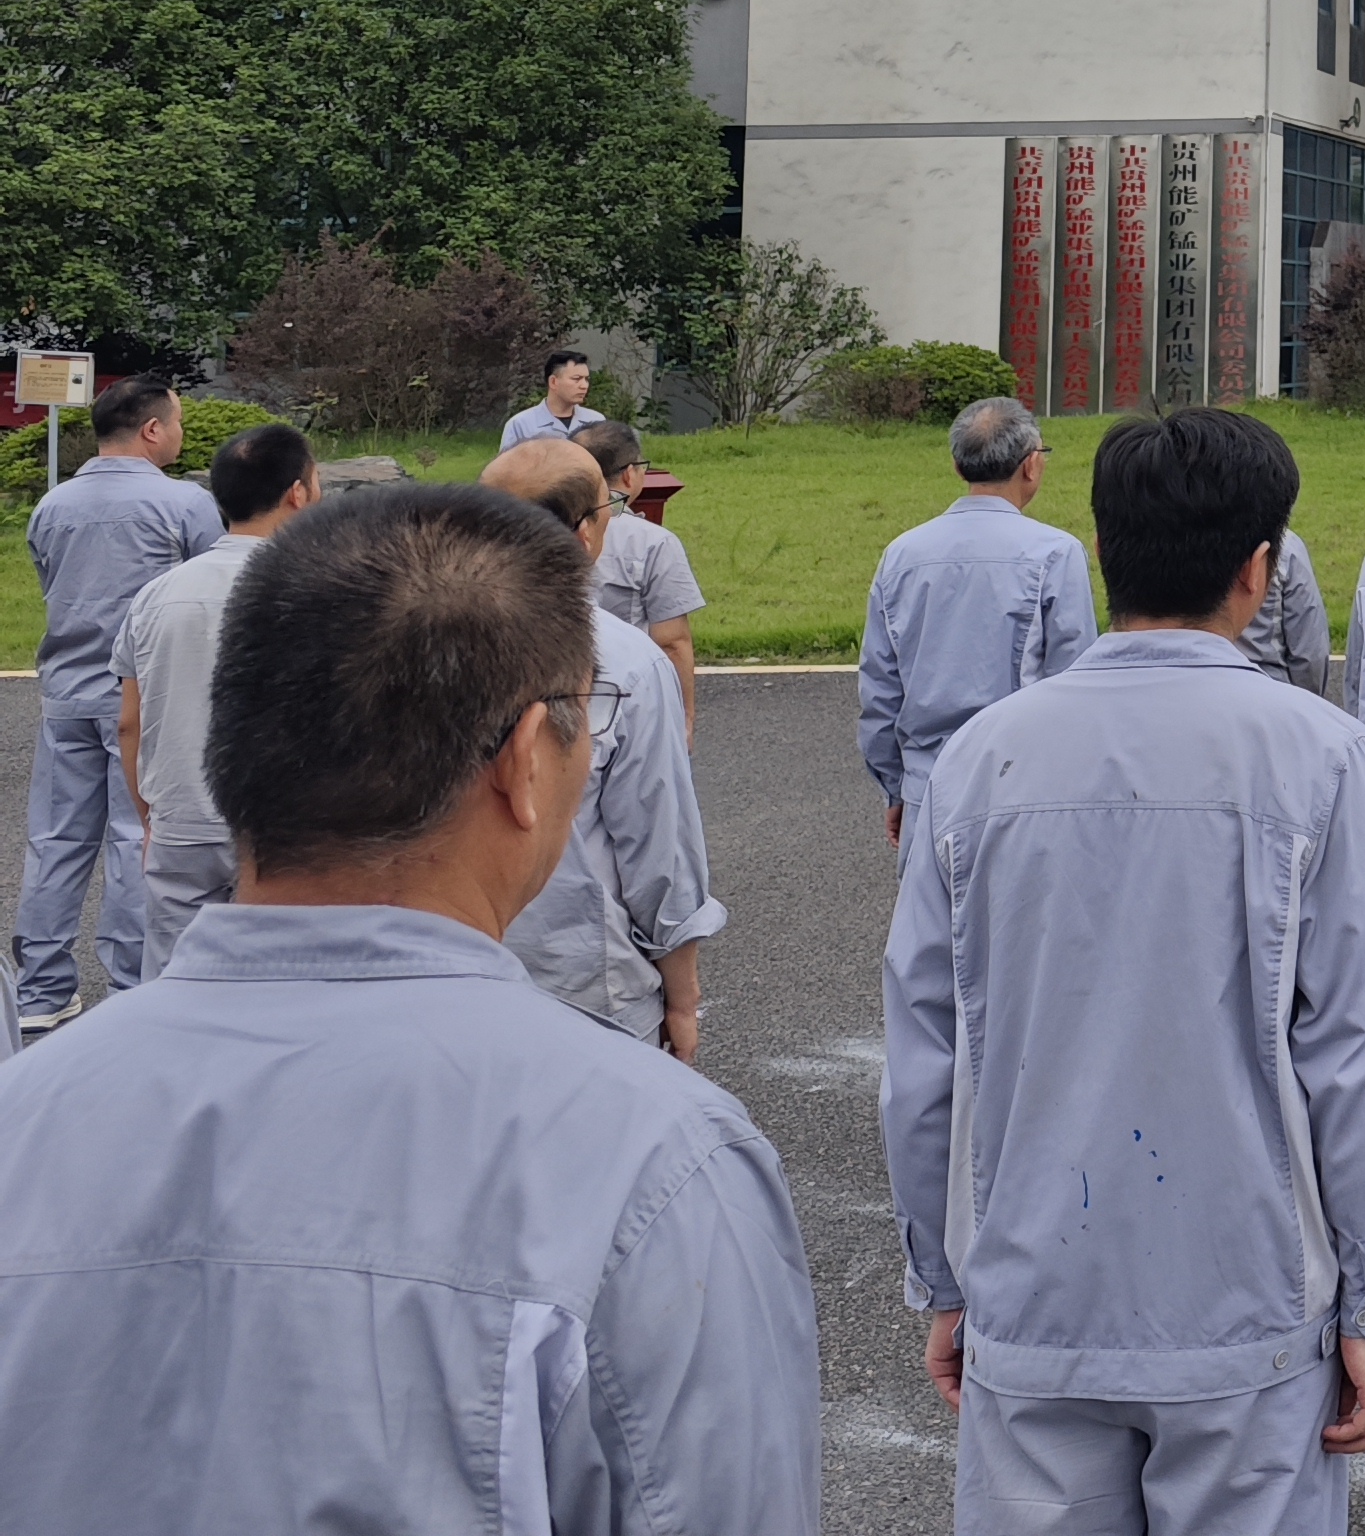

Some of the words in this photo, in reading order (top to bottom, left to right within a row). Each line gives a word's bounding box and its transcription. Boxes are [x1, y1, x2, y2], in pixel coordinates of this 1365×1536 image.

[1165, 140, 1200, 405] 贵州能矿锰业集团有限公司
